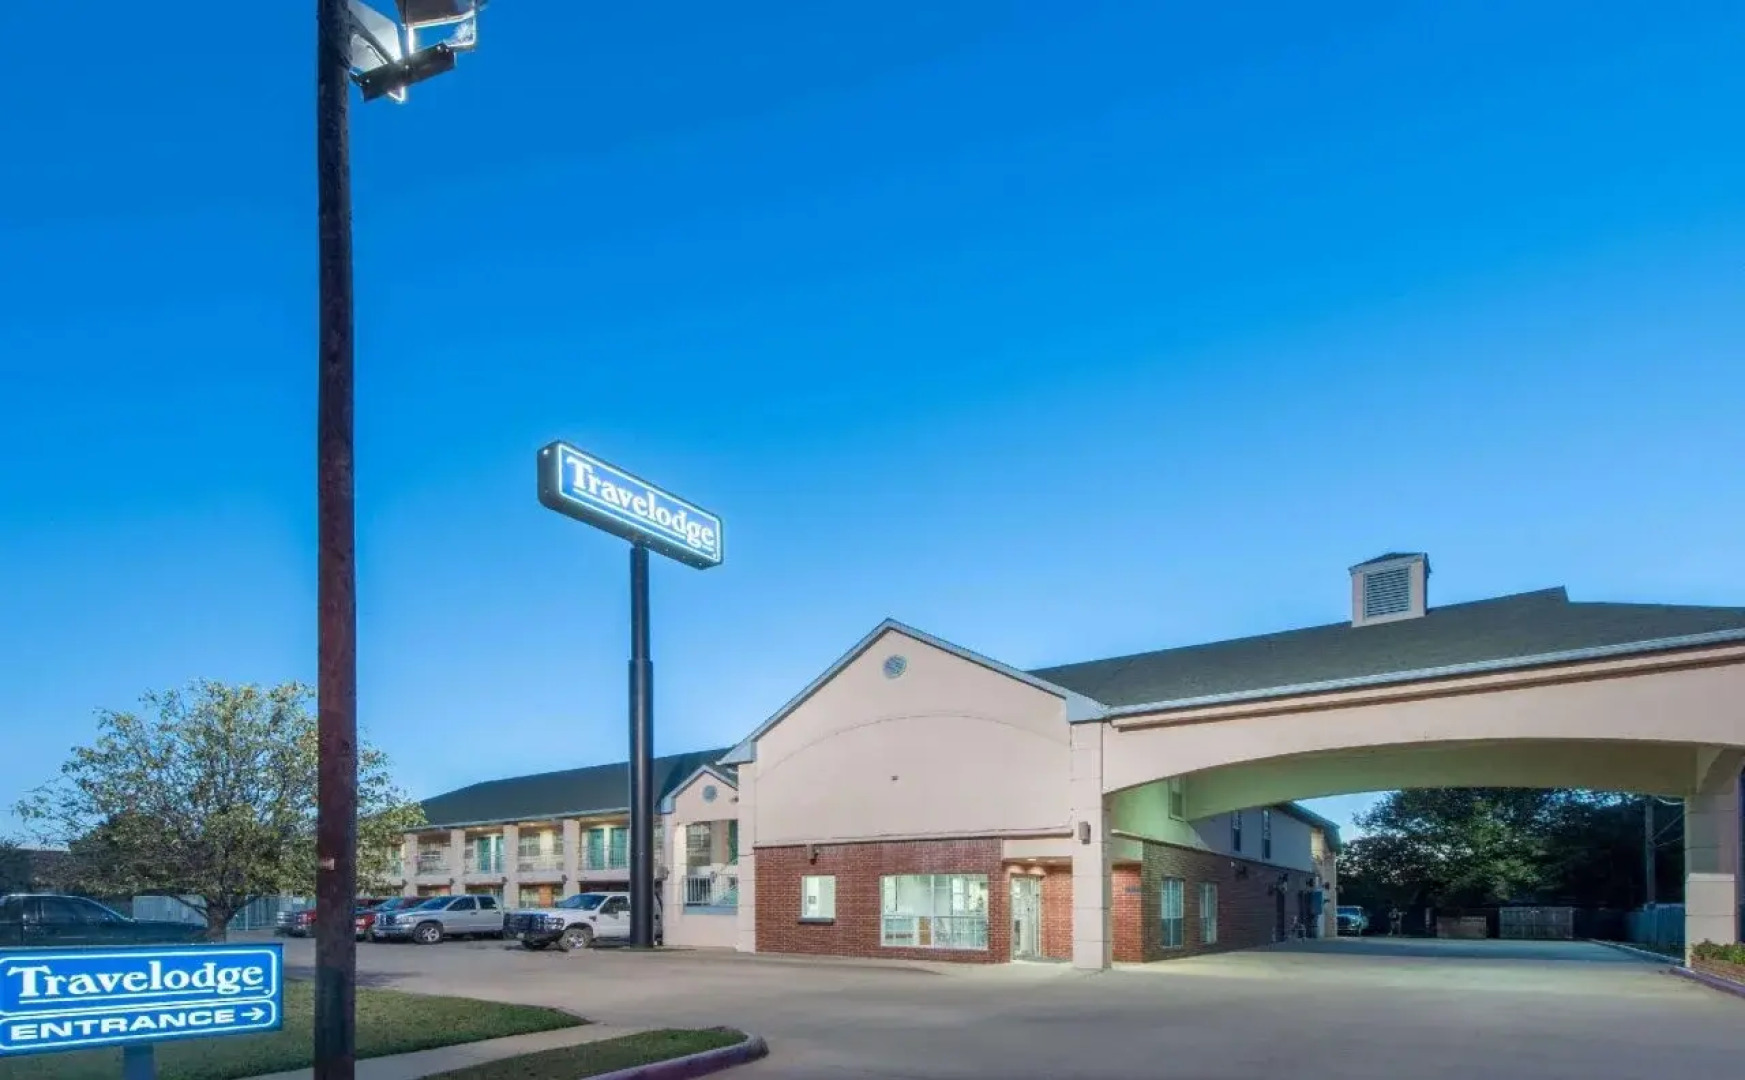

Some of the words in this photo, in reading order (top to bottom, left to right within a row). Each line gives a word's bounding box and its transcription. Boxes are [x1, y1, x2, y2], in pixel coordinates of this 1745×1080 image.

[566, 456, 715, 548] Travelodge
[7, 960, 264, 998] Travelodge
[10, 1009, 236, 1040] ENTRANCE
